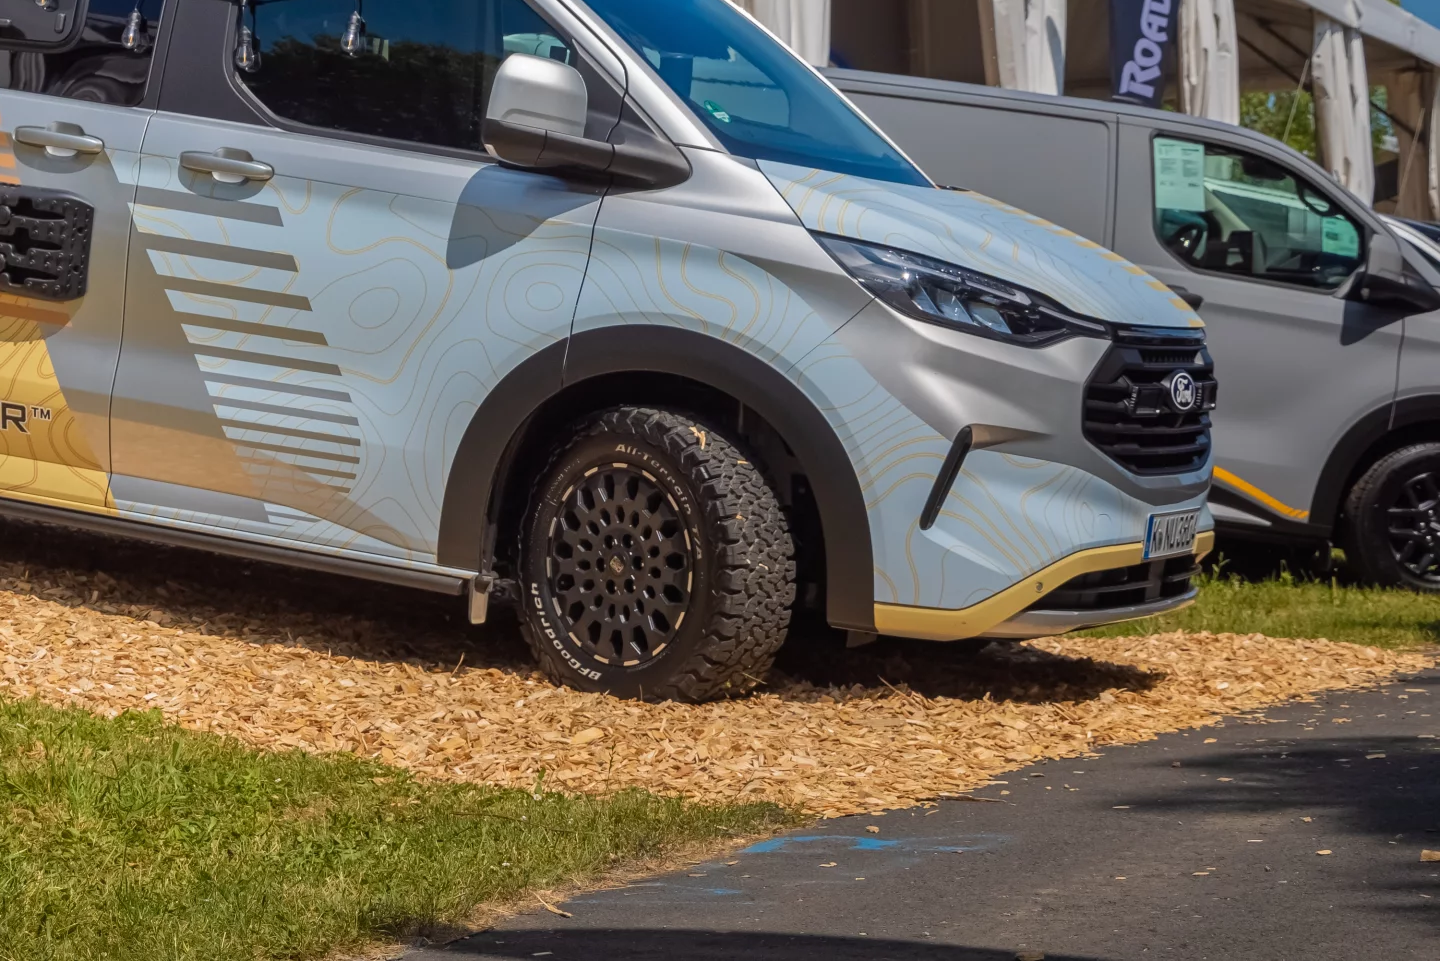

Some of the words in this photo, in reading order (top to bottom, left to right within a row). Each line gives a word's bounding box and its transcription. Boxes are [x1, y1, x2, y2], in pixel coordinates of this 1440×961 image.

[614, 443, 692, 515] All-Terrain
[691, 524, 703, 560] T/A
[530, 582, 603, 681] BFGoodrich
